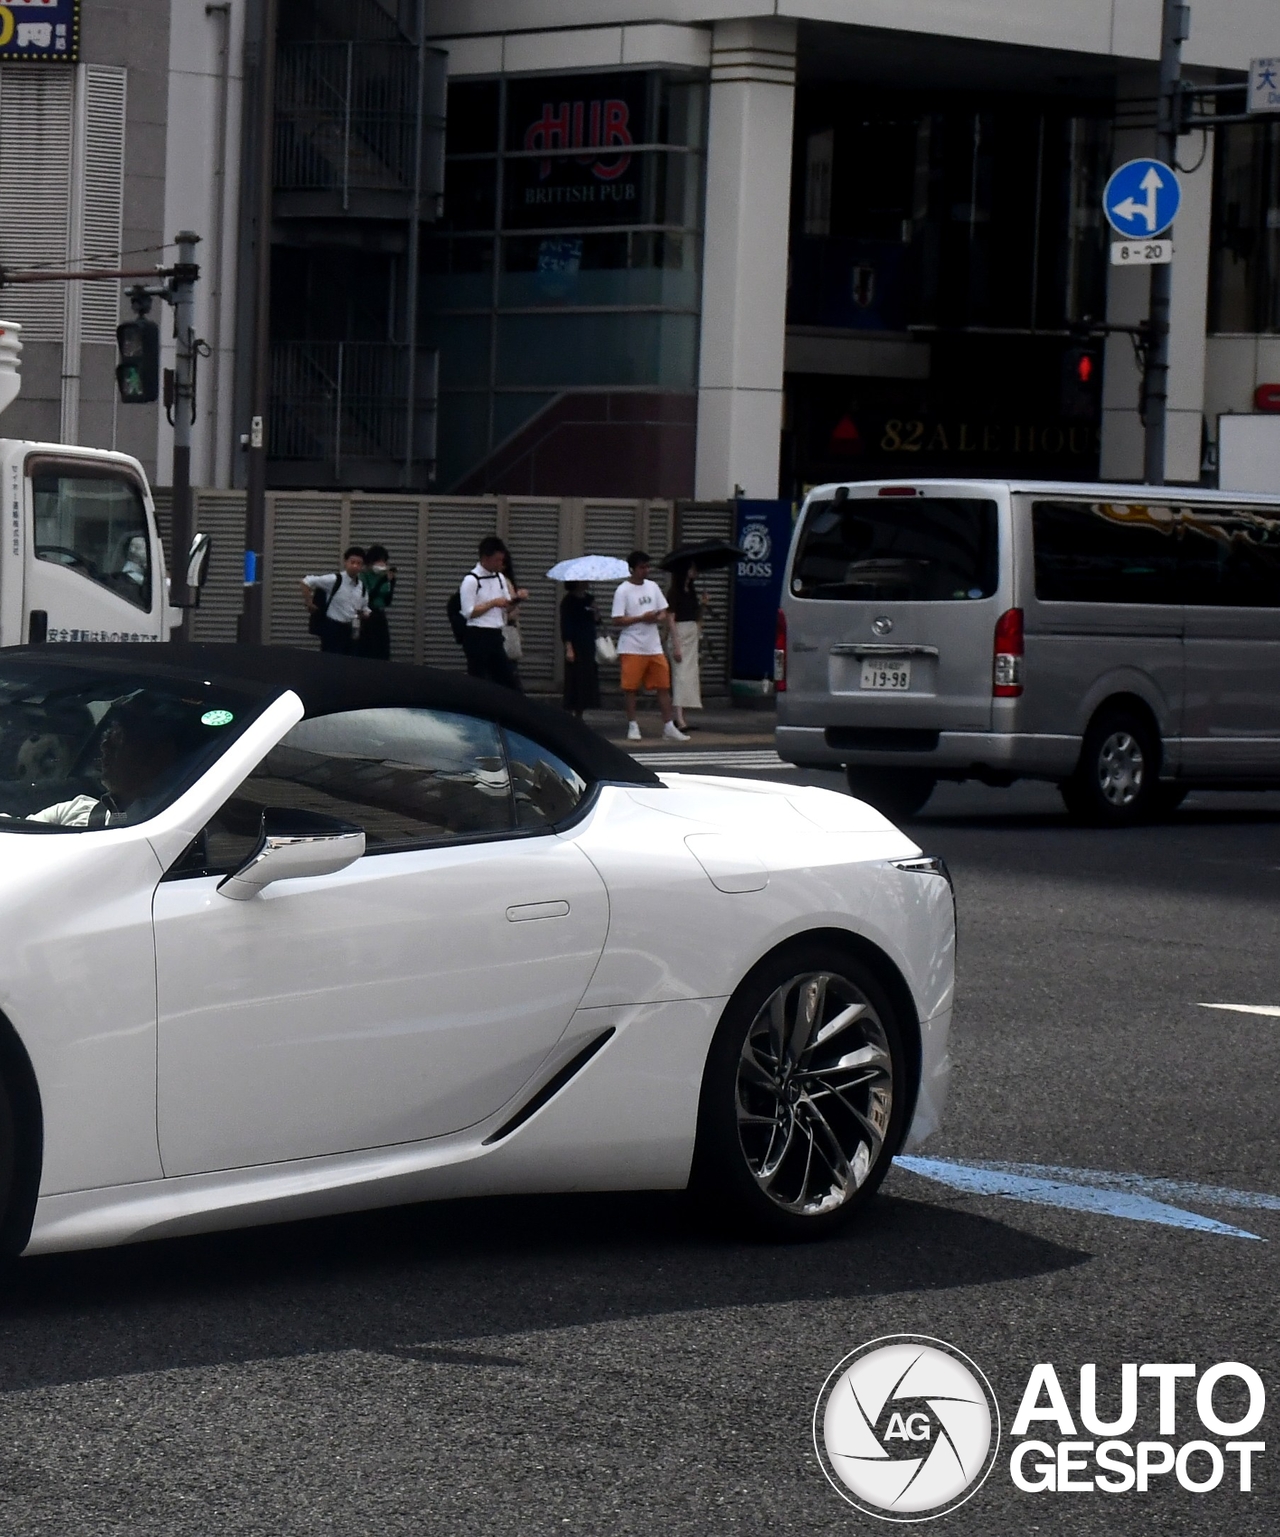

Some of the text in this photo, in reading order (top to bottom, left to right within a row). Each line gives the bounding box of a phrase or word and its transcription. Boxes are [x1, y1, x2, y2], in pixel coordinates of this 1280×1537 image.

[523, 98, 634, 182] HUB
[524, 182, 636, 206] BRITISH PUB
[880, 417, 925, 453] 82
[737, 561, 773, 579] BOSS
